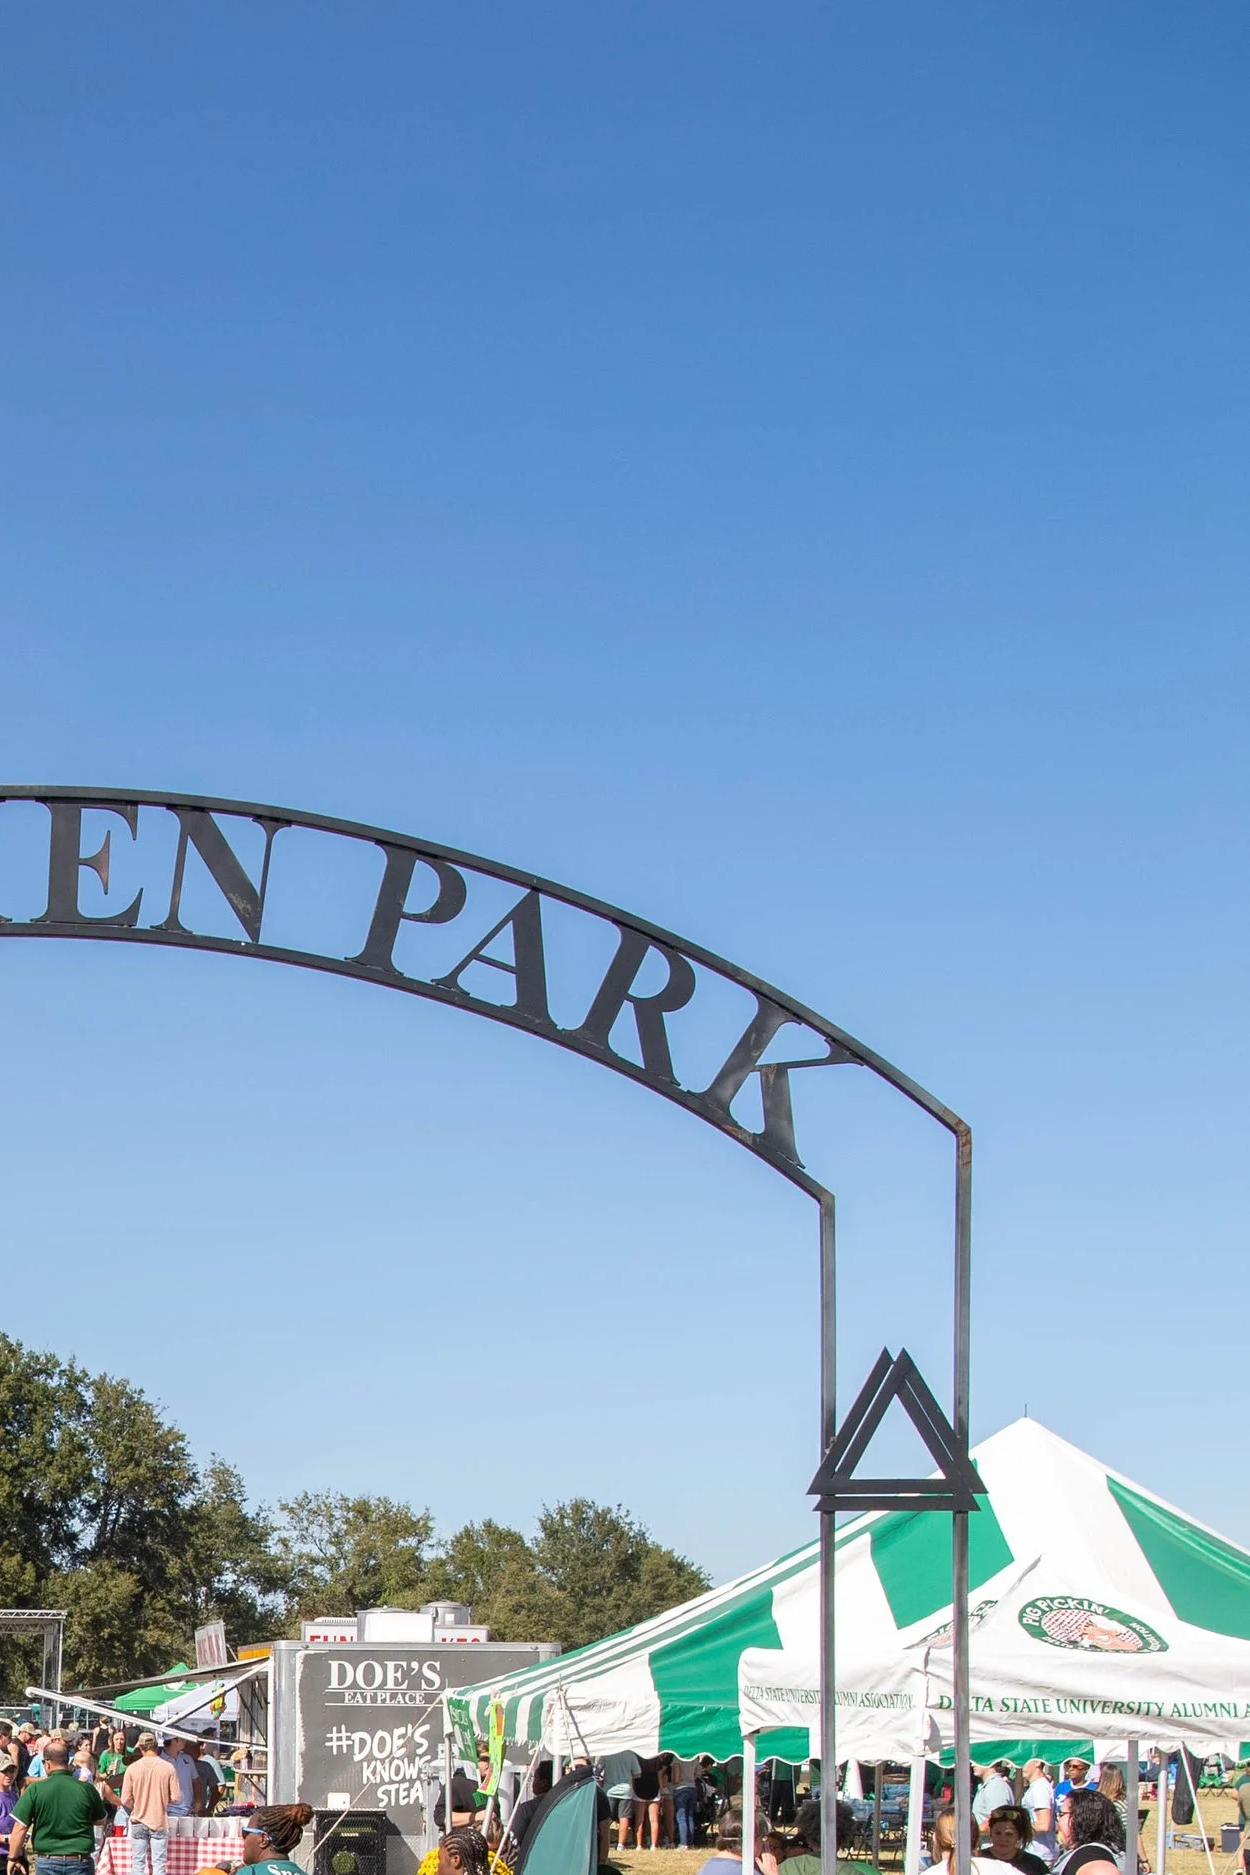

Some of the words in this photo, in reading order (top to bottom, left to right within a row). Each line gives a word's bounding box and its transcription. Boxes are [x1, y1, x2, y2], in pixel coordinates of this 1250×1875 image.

[345, 840, 866, 1169] PARK
[1023, 1606, 1039, 1626] PIG
[1035, 1598, 1110, 1615] PICKIN'
[328, 1660, 441, 1691] DOE'S
[344, 1692, 374, 1704] EAT
[375, 1692, 425, 1705] PLACE
[999, 1697, 1052, 1713] STATE
[1056, 1698, 1165, 1717] UNIVERSITY
[1170, 1701, 1239, 1718] ALUMNI
[325, 1724, 432, 1762] #DOE'S
[377, 1780, 424, 1808] STEA
